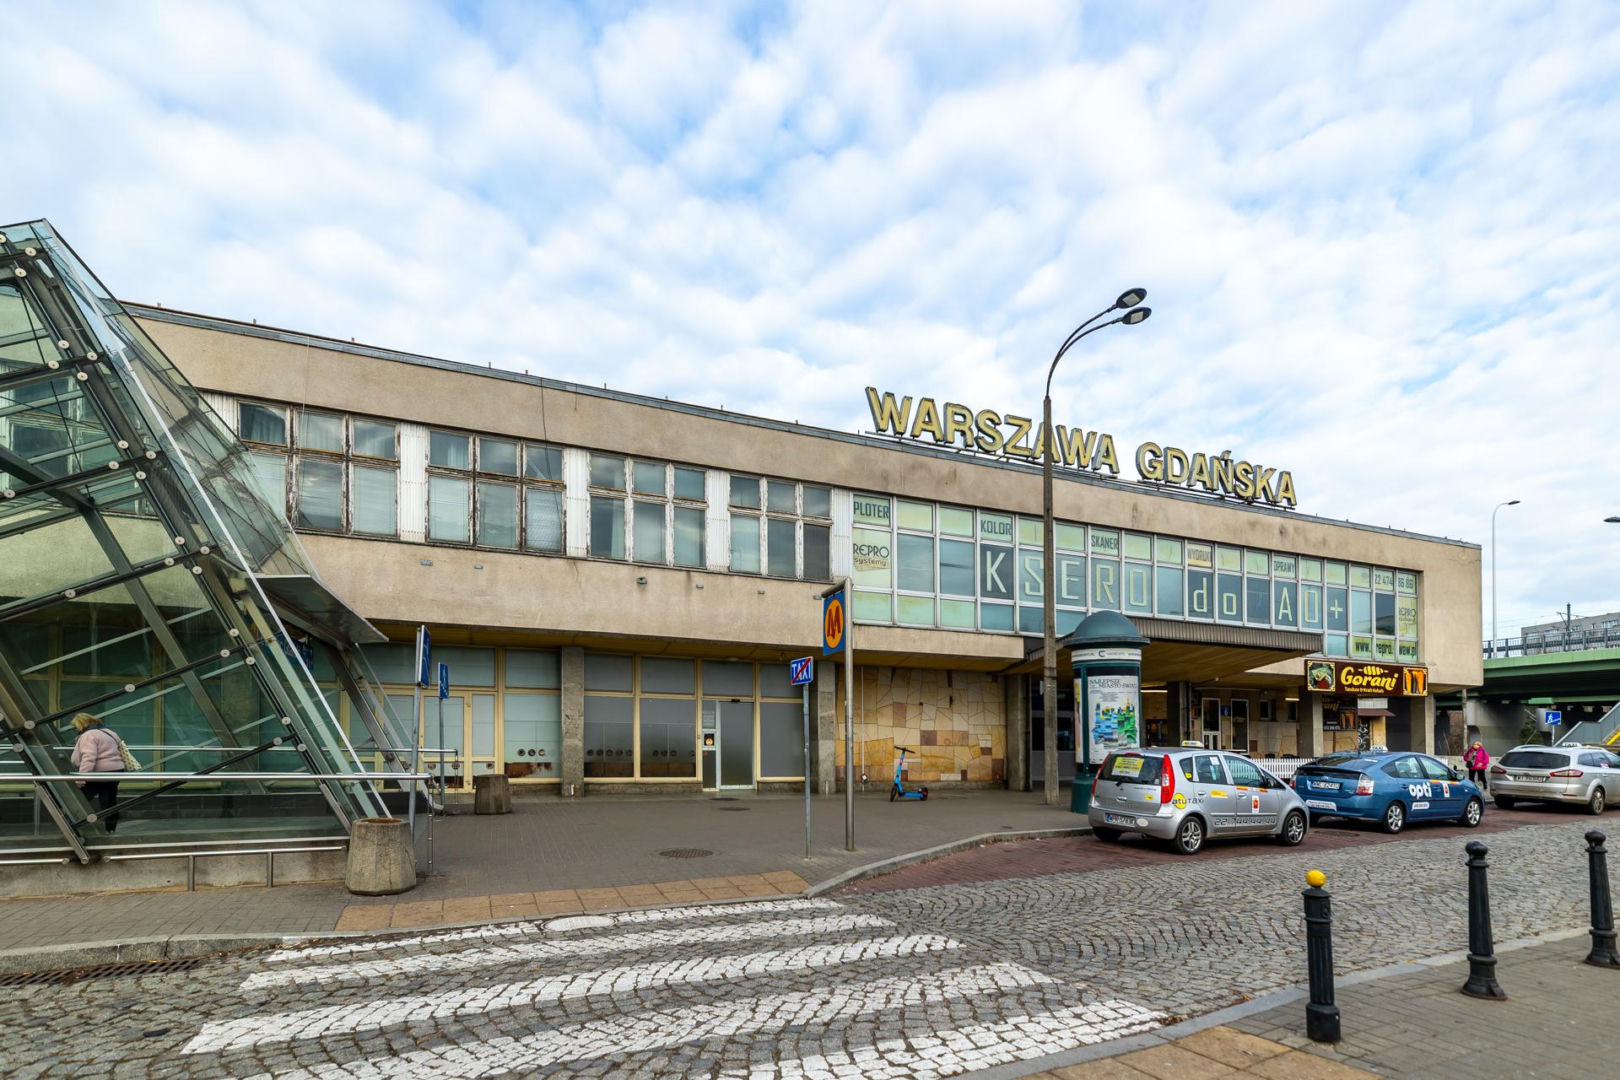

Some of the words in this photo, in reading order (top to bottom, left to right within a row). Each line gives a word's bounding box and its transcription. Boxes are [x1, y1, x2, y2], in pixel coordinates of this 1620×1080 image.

[865, 386, 1120, 474] WARSZAWA
[1136, 441, 1297, 506] GDAŃSKA
[853, 501, 889, 519] PLOTER
[980, 519, 1012, 536] KOLOR
[853, 543, 889, 559] REPRO
[1091, 534, 1119, 550] SKANER
[792, 660, 811, 681] TAXI
[1341, 666, 1399, 691] Gorani
[1409, 782, 1432, 800] opti
